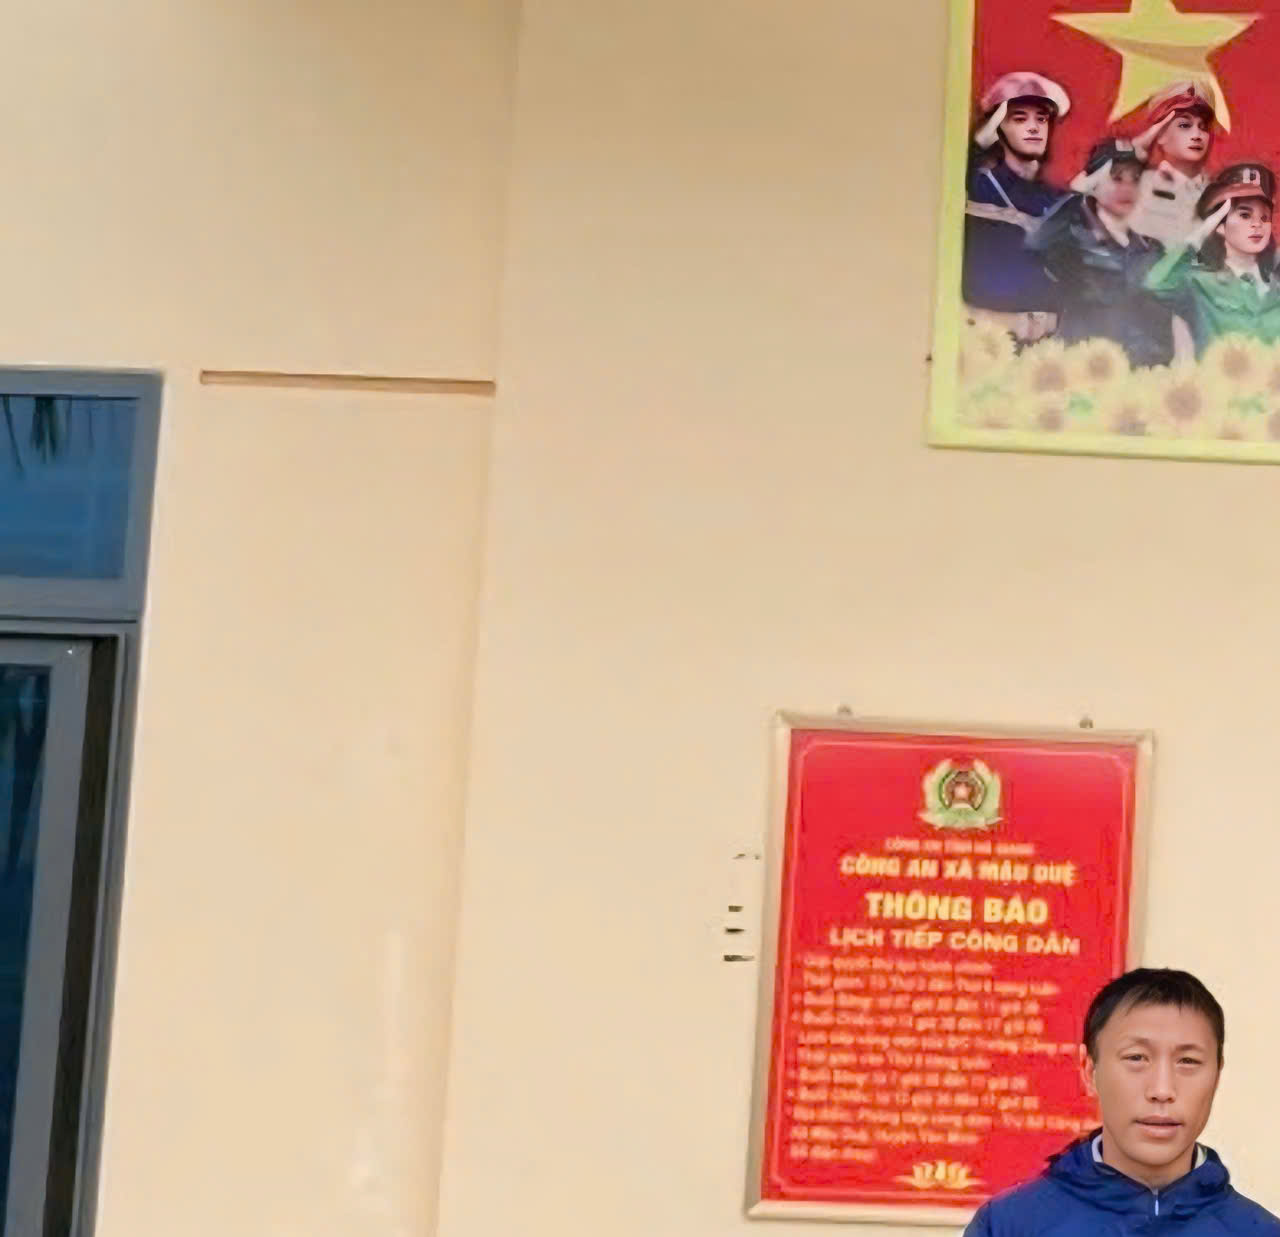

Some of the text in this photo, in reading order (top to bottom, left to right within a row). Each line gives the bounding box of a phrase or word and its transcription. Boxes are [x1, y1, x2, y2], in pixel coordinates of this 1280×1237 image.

[840, 852, 900, 877] CÔNG
[906, 858, 940, 879] AN
[865, 890, 1049, 925] THÔNG BÁO
[828, 923, 1081, 956] LỊCH TIẾP CÔNG DÂN
